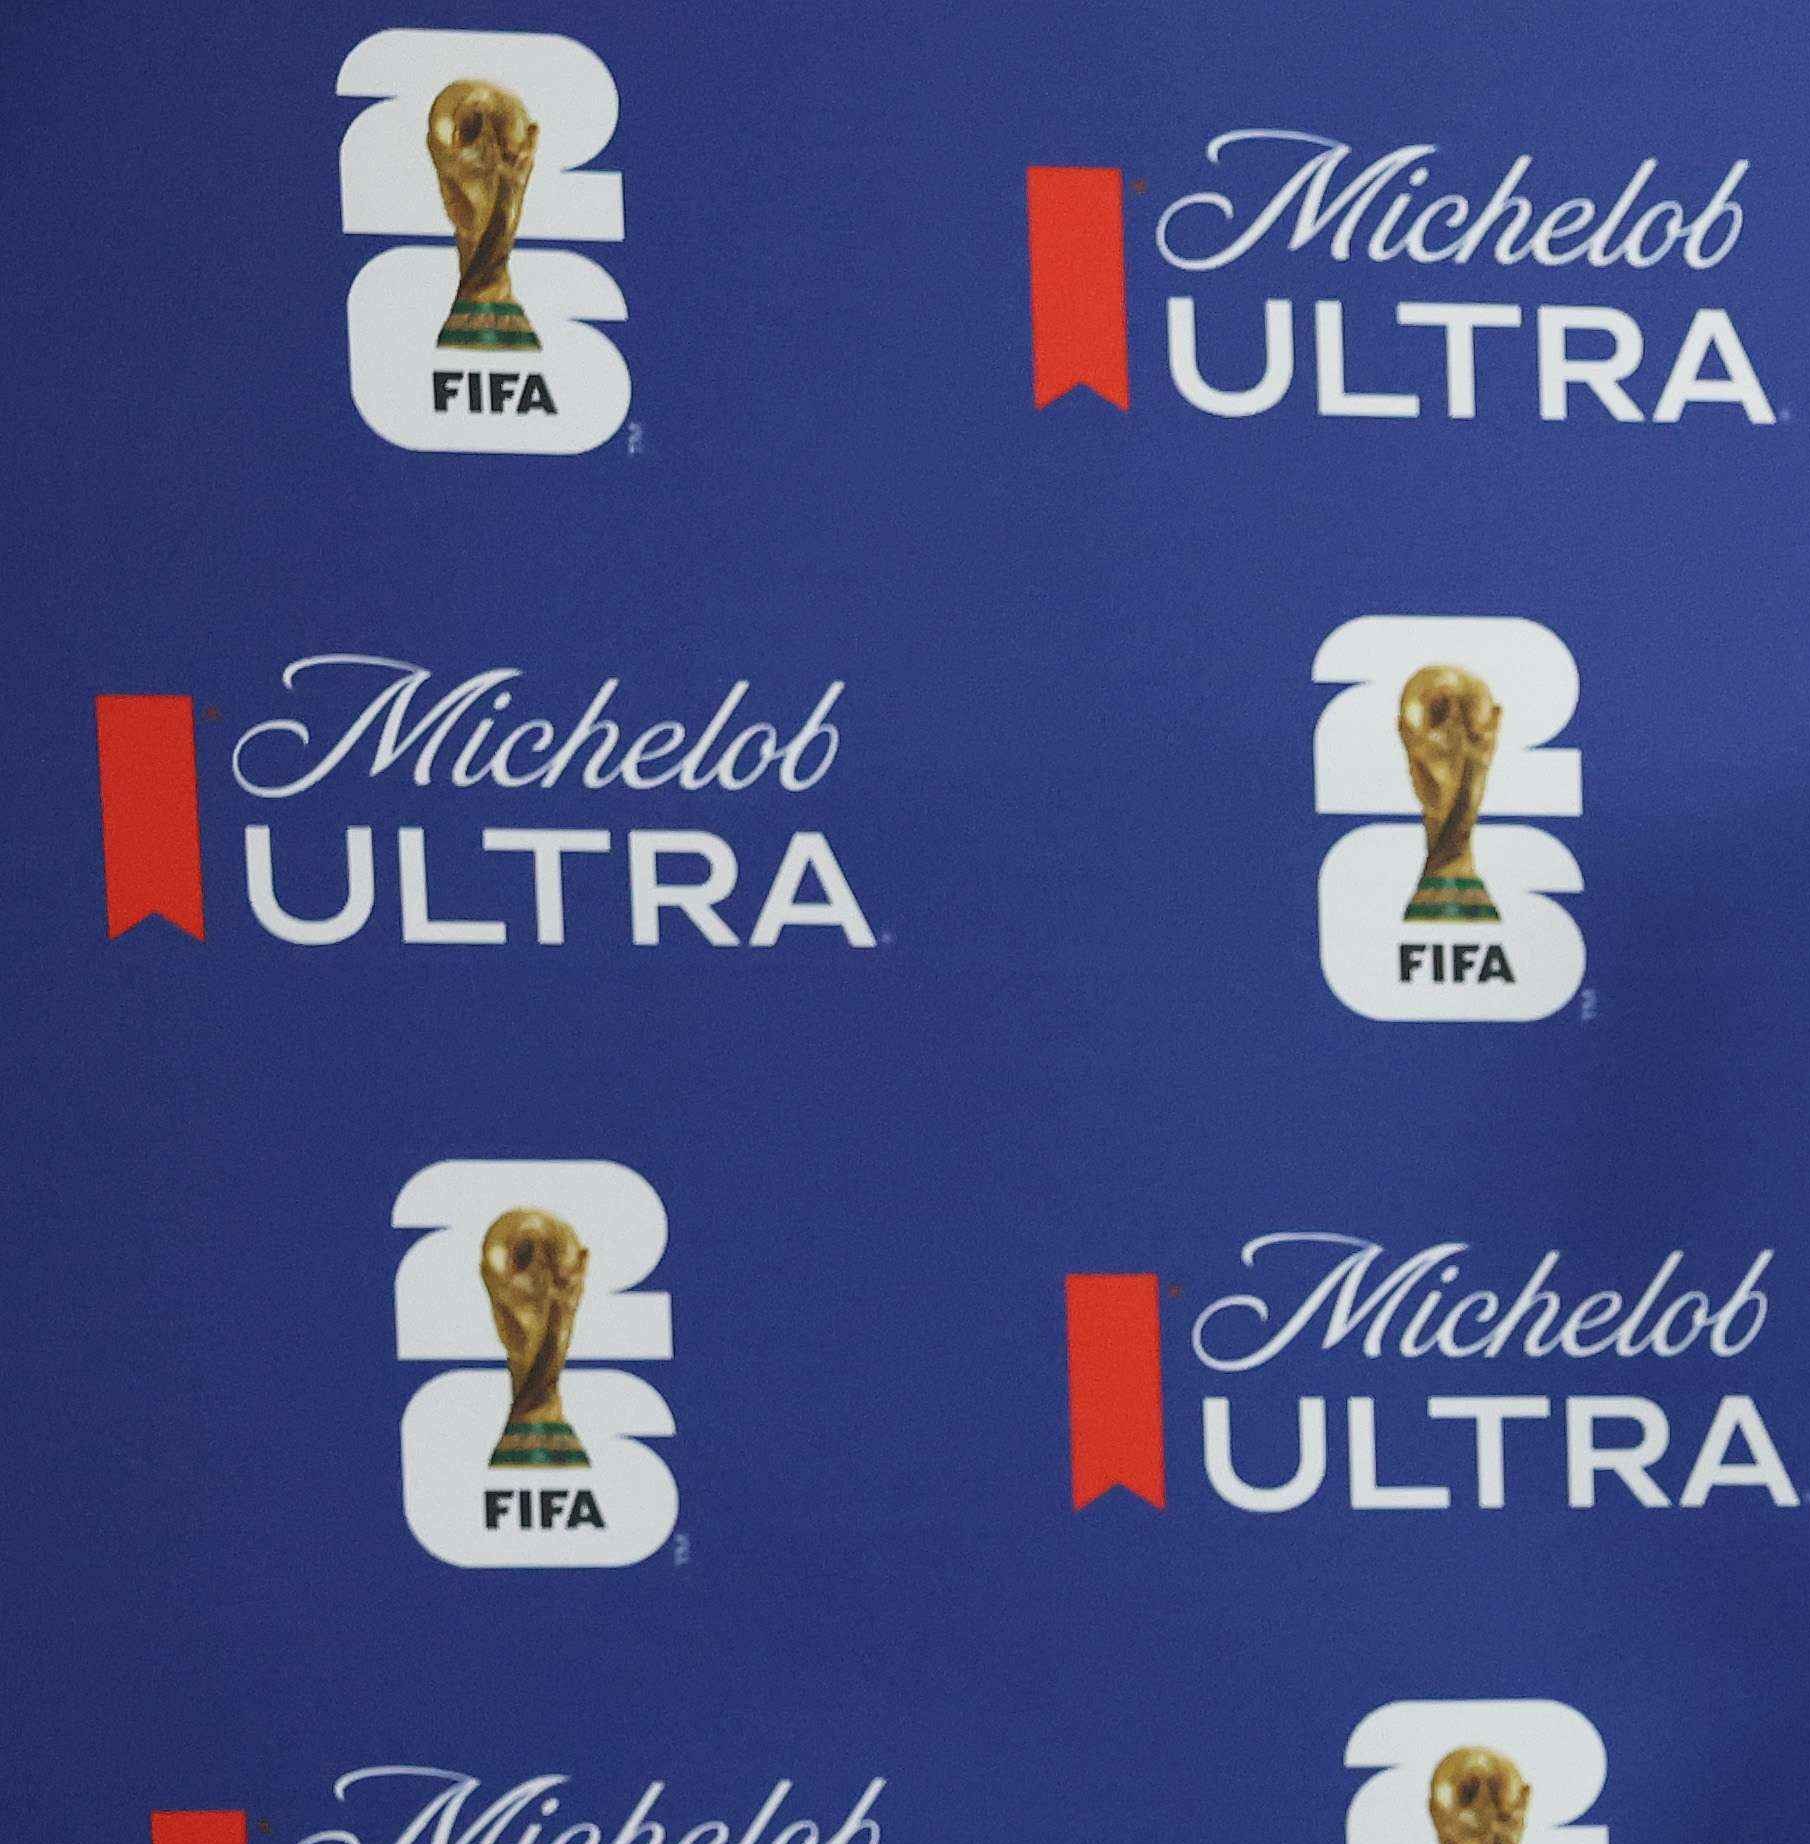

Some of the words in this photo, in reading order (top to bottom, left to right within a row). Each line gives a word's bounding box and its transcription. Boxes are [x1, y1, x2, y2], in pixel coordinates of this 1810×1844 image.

[1156, 129, 1749, 271] Michelob
[432, 370, 557, 415] FIFA
[1166, 296, 1777, 425] ULTRA
[232, 654, 845, 798] Michelob
[244, 825, 877, 948] ULTRA
[1399, 943, 1515, 984] FIFA
[1192, 1232, 1773, 1372] Michelob
[484, 1489, 605, 1530] FIFA
[1202, 1395, 1800, 1513] ULTRA
